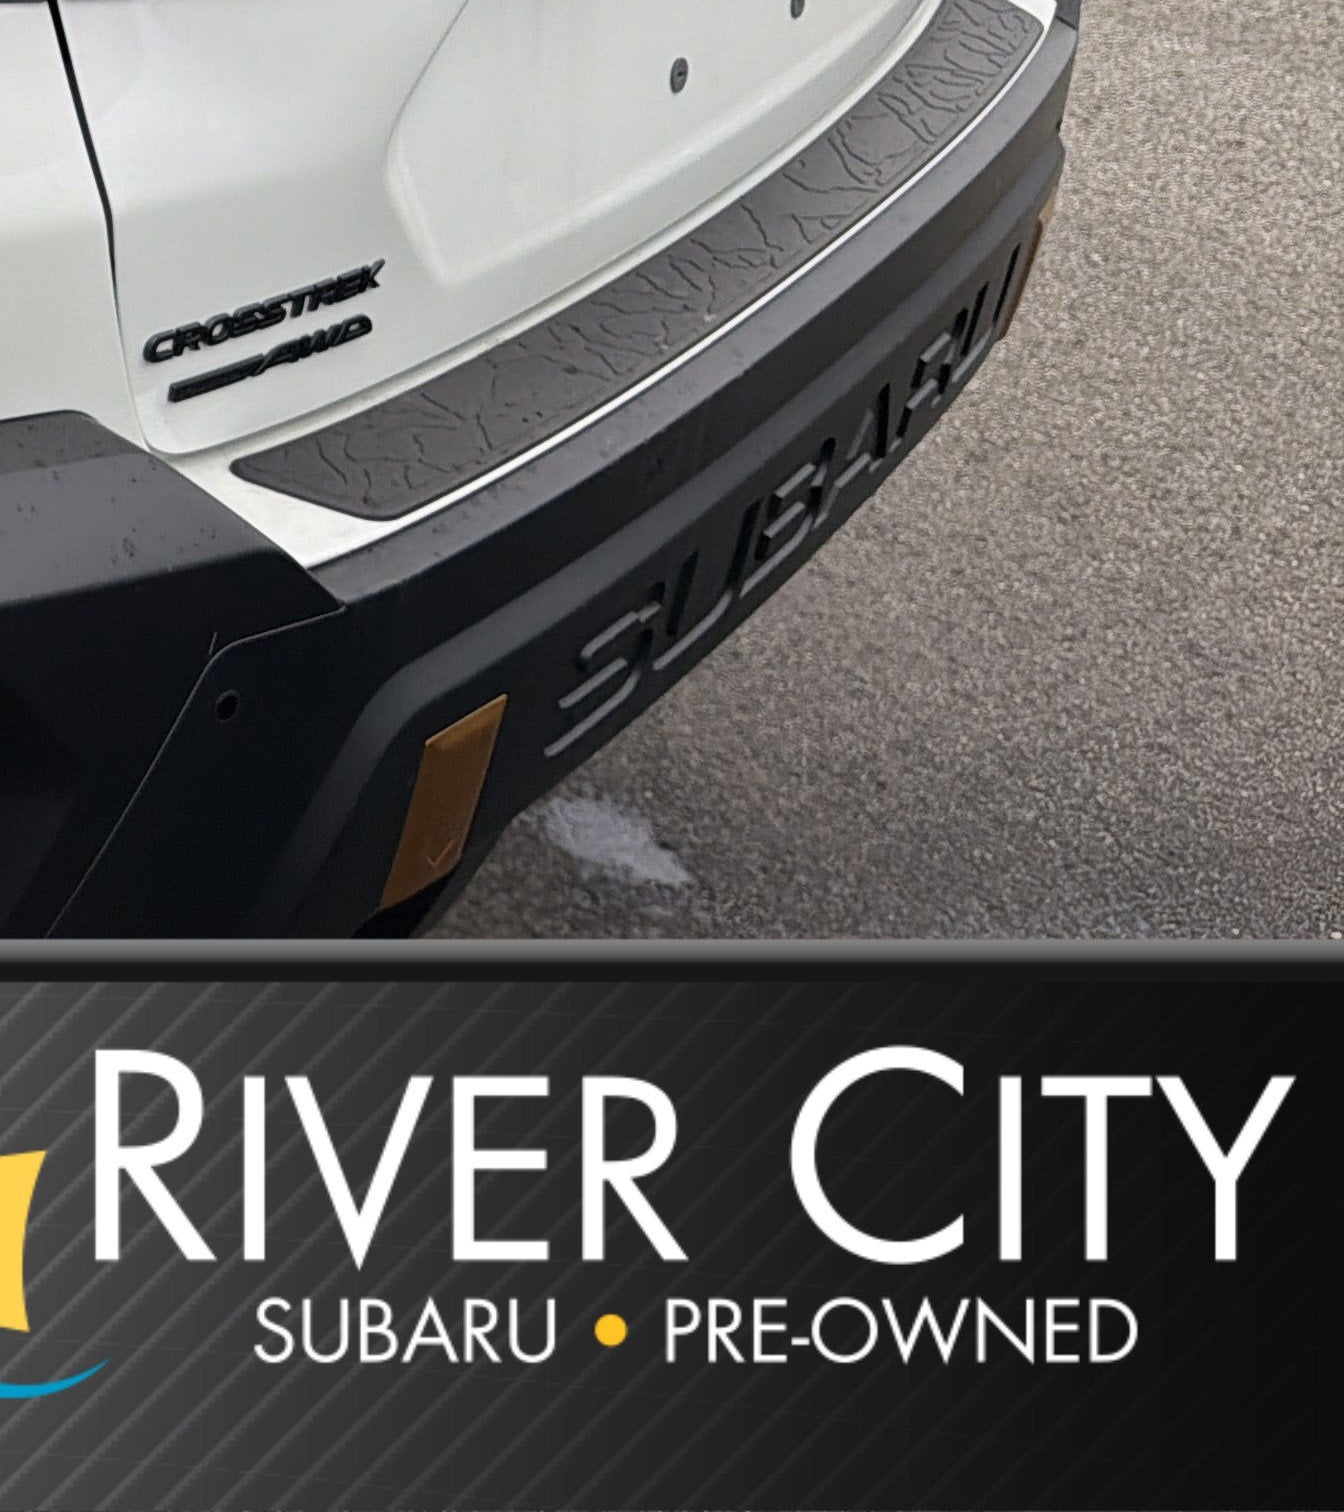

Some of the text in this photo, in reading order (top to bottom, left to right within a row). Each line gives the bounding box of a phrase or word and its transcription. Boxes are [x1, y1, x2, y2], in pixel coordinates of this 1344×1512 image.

[143, 258, 386, 363] CROSSTREK
[253, 313, 373, 376] AWD
[543, 243, 1021, 758] SUBARU
